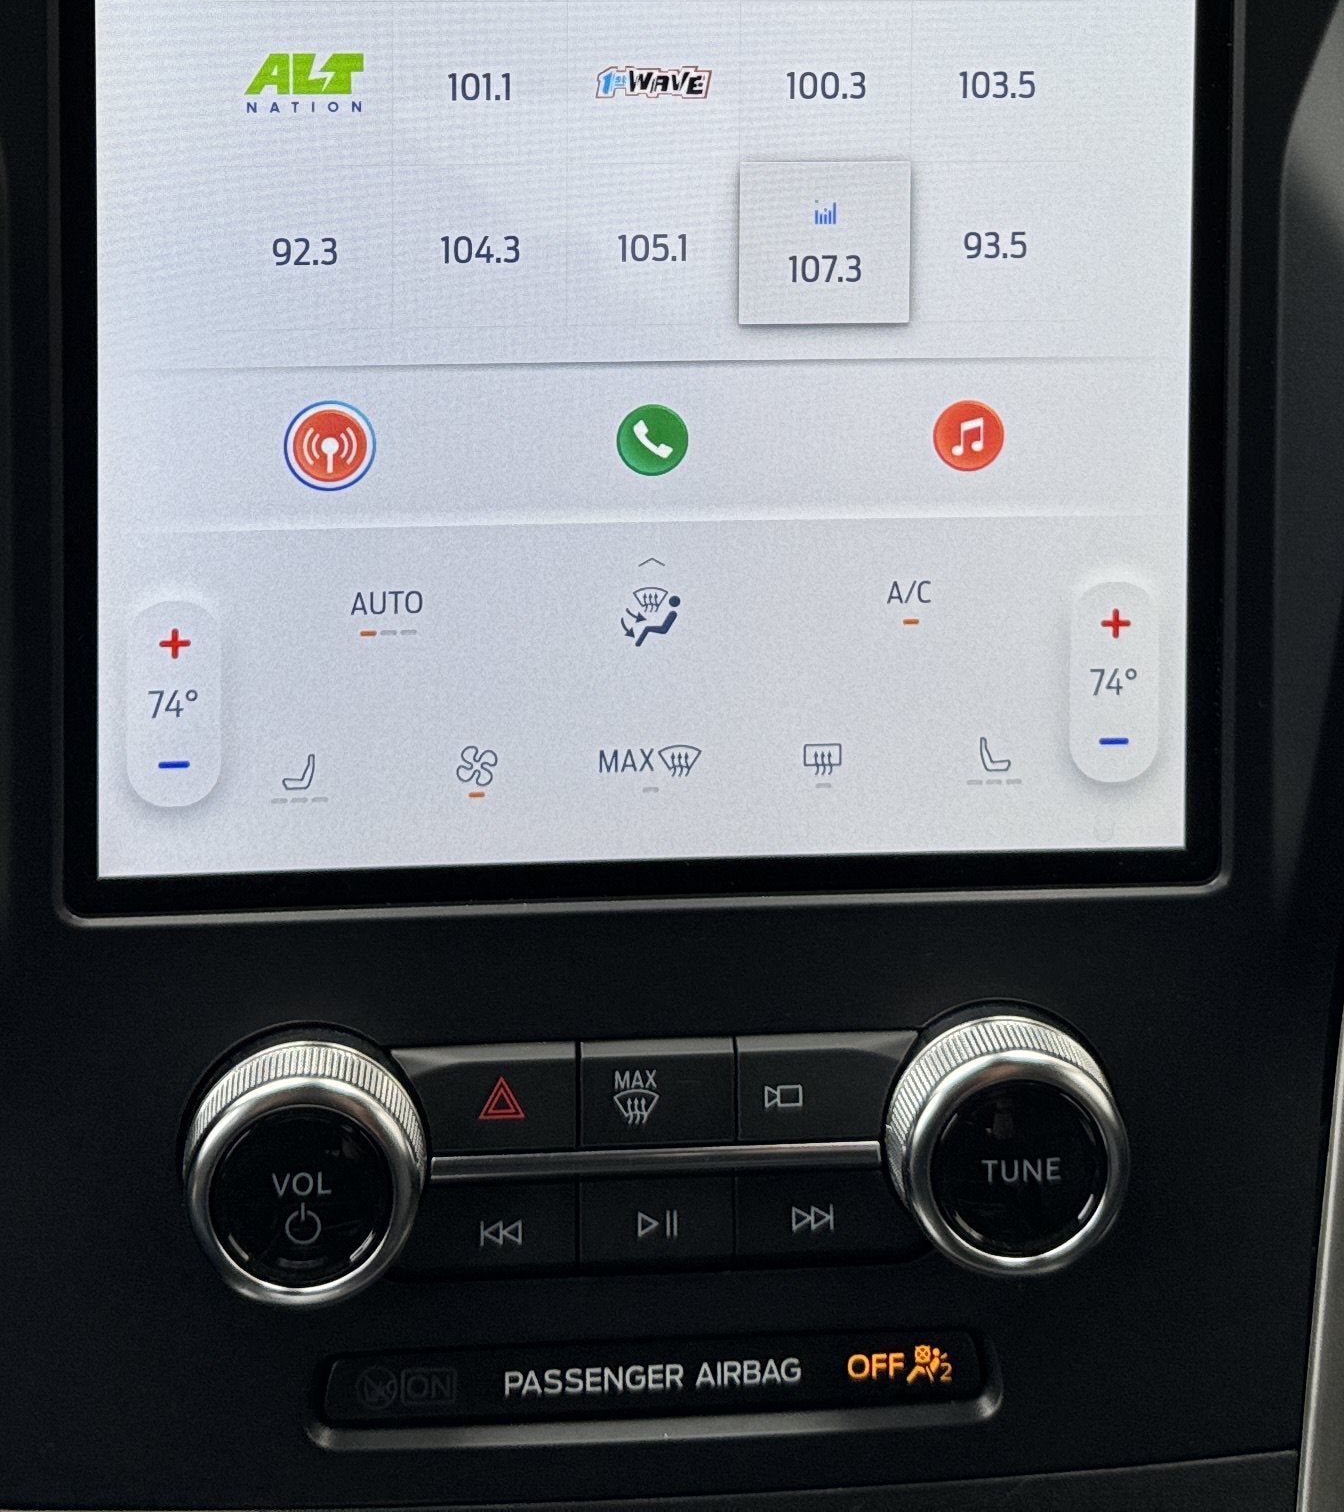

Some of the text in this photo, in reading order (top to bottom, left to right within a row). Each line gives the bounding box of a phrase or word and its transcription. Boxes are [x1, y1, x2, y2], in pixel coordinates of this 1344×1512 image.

[245, 53, 364, 94] ALT
[448, 73, 510, 101] 101.1
[629, 70, 705, 94] WAVE
[787, 72, 865, 99] 100.3
[960, 71, 1035, 98] 103.5
[247, 101, 361, 113] NATION
[273, 238, 337, 265] 92.3
[441, 236, 519, 263] 104.3
[618, 234, 686, 262] 105.1
[964, 232, 1026, 258] 93.5
[789, 255, 861, 282] 107.3
[351, 591, 422, 615] AUTO
[887, 581, 931, 603] A/C
[1090, 668, 1137, 695] 74°
[149, 690, 198, 718] 74°
[598, 748, 655, 774] MAX
[614, 1071, 658, 1090] MAX
[982, 1158, 1060, 1182] TUNE
[273, 1172, 331, 1196] VOL
[505, 1358, 801, 1395] PASSENGER AIRBAG
[847, 1352, 905, 1380] OFF
